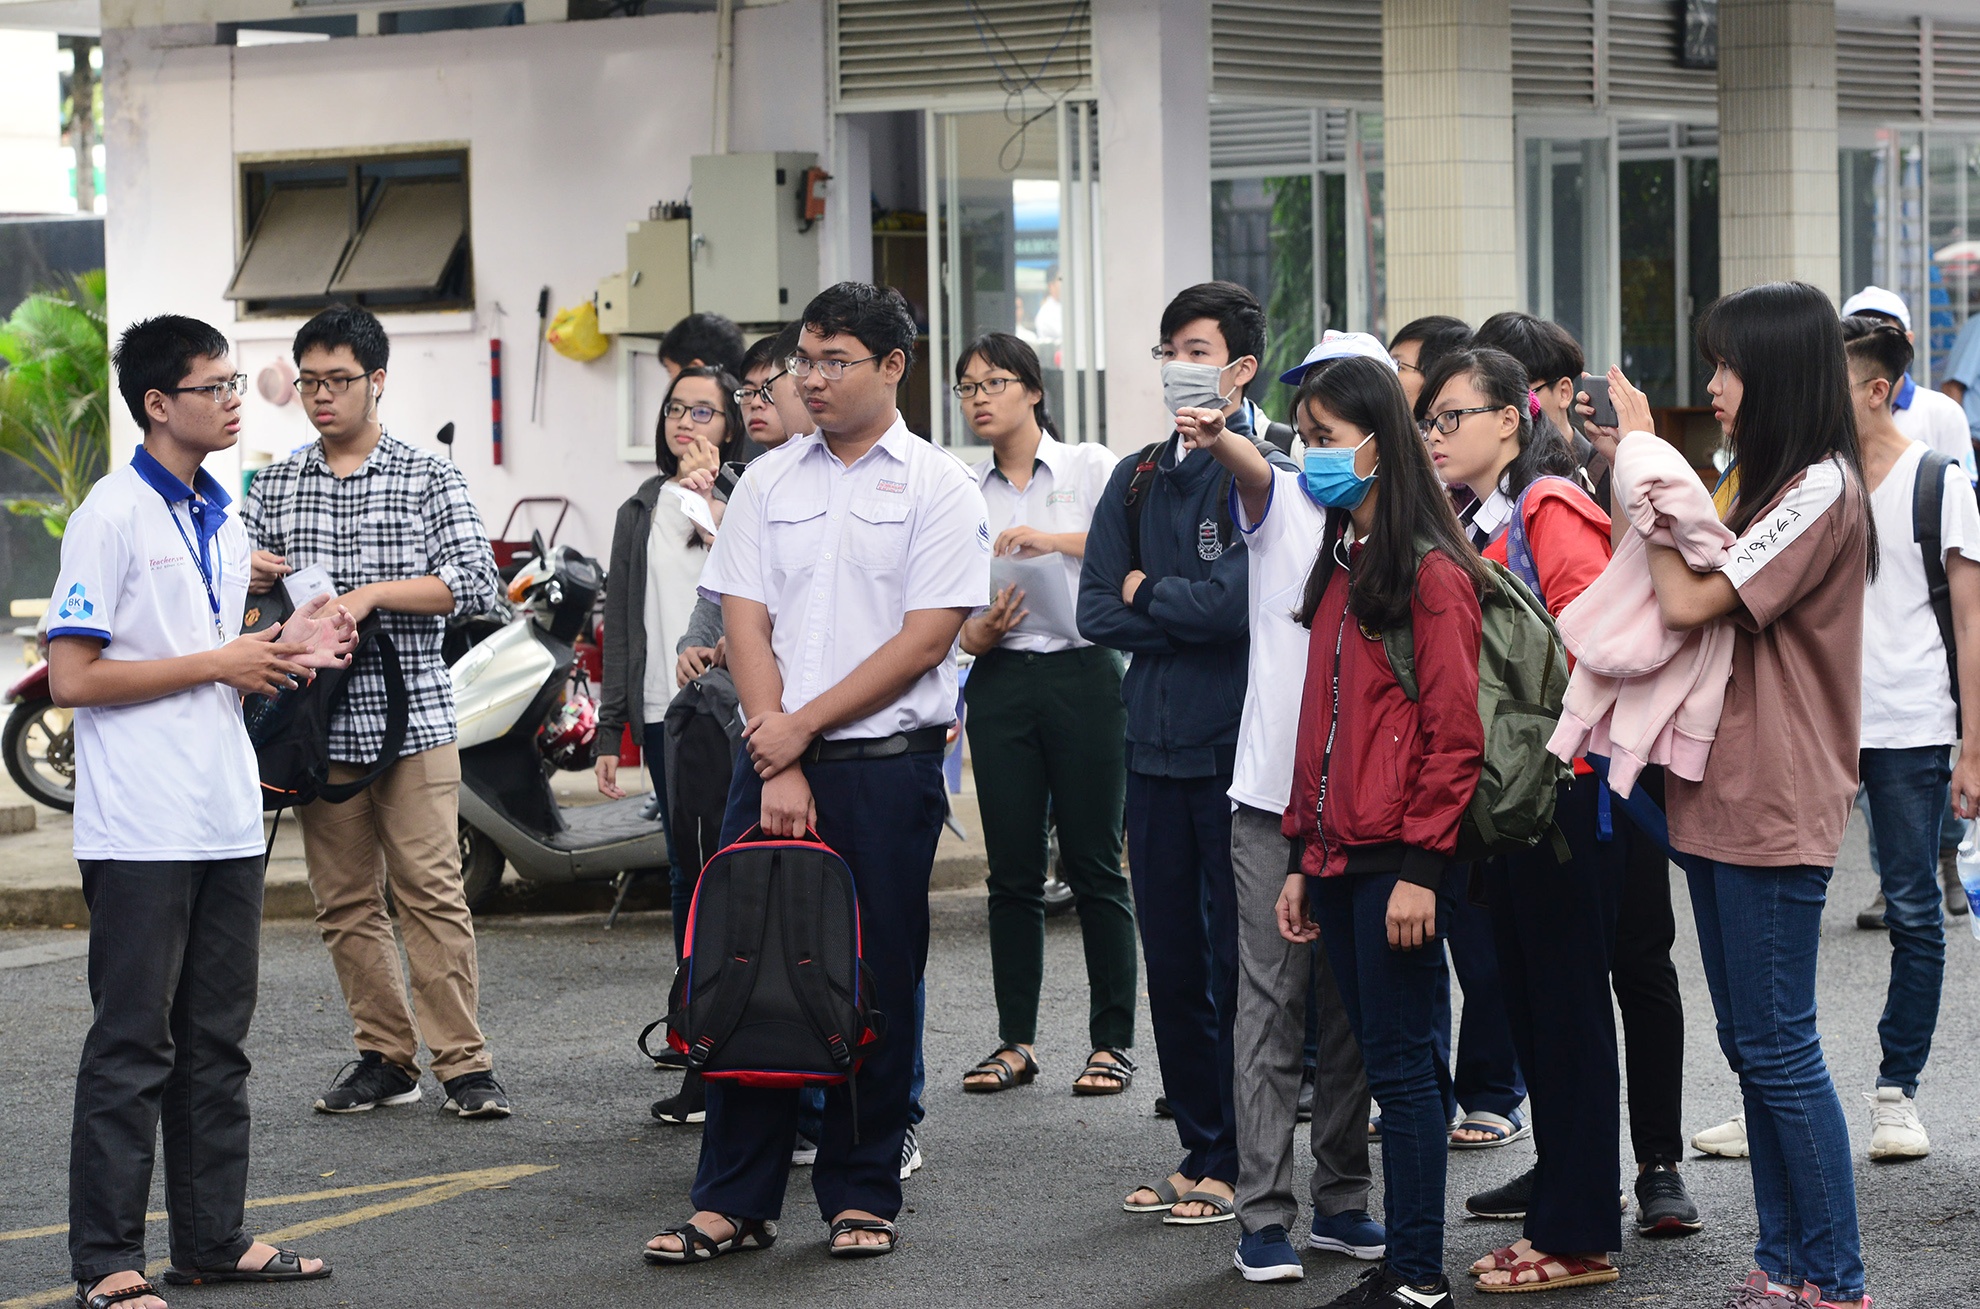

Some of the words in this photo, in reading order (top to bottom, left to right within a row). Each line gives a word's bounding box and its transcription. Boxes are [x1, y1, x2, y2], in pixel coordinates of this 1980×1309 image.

[1737, 508, 1801, 563] ドラえもん
[68, 597, 81, 607] BK
